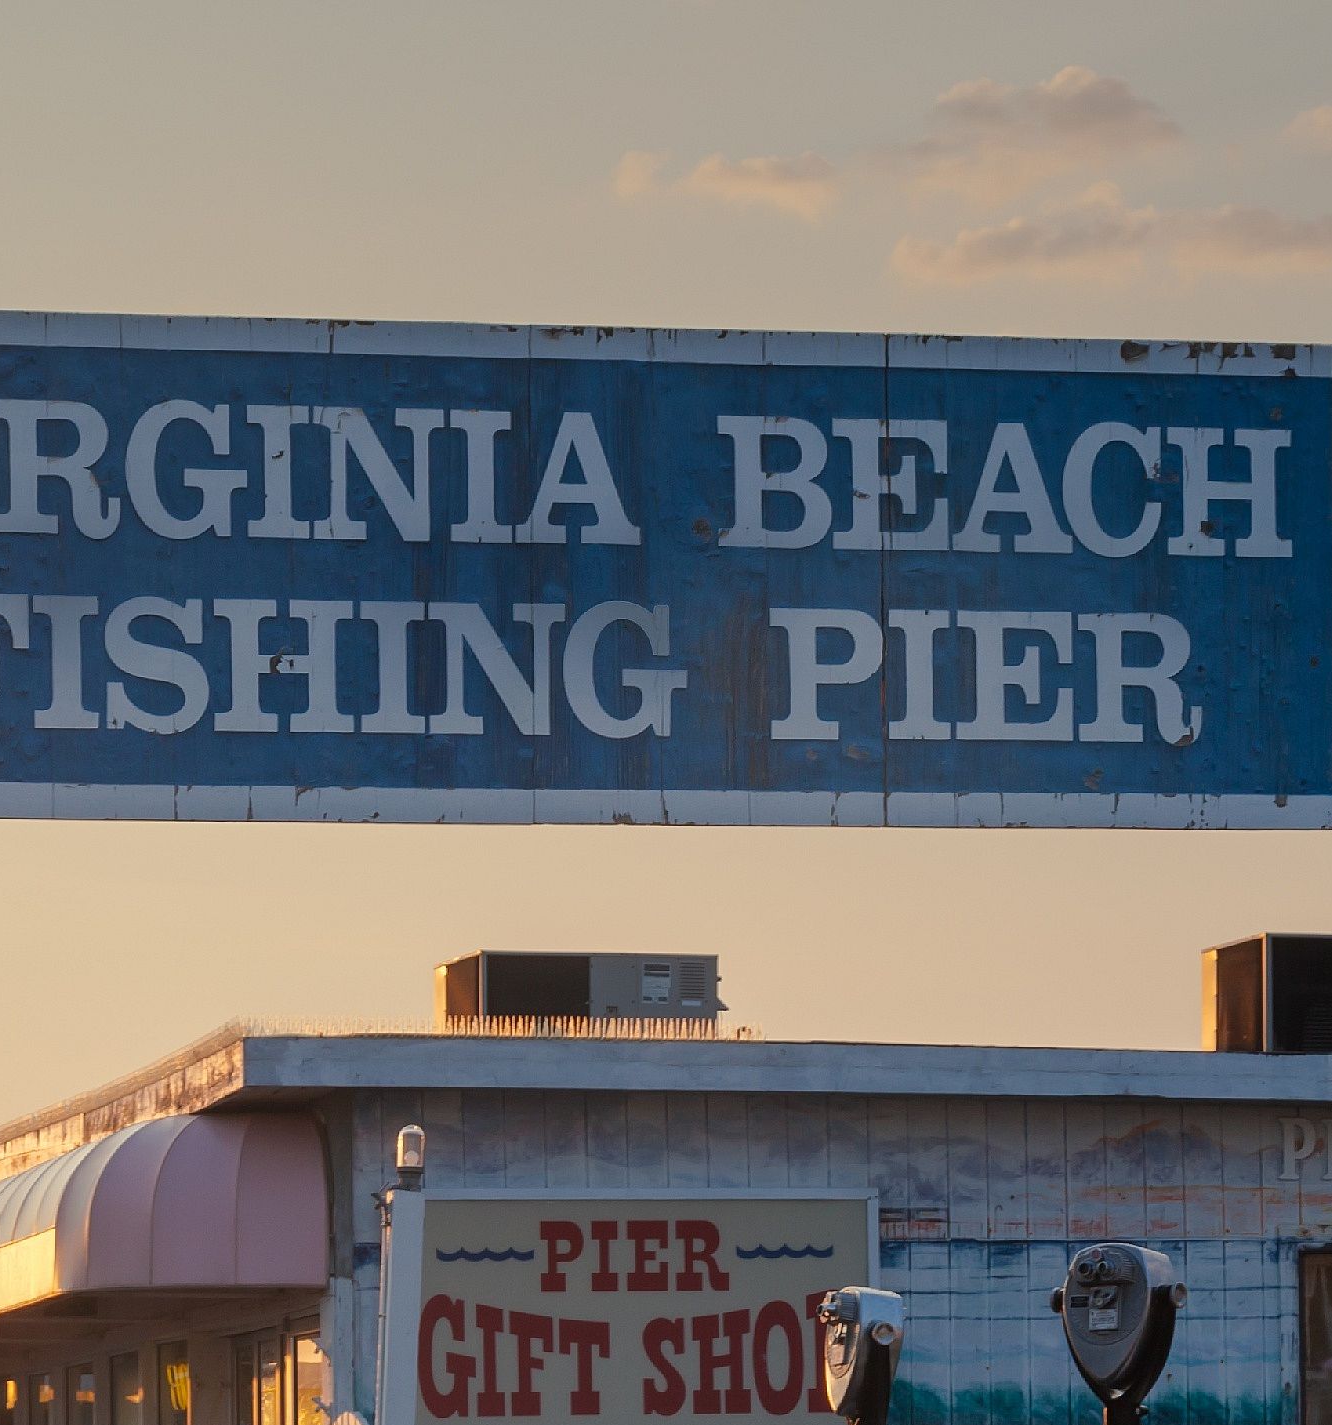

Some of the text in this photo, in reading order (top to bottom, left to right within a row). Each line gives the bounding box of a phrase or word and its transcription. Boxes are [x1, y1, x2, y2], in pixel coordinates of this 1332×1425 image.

[717, 415, 1293, 559] BEACH
[769, 607, 1203, 746] PIER
[539, 1219, 730, 1292] PIER
[417, 1293, 610, 1419] GIFT
